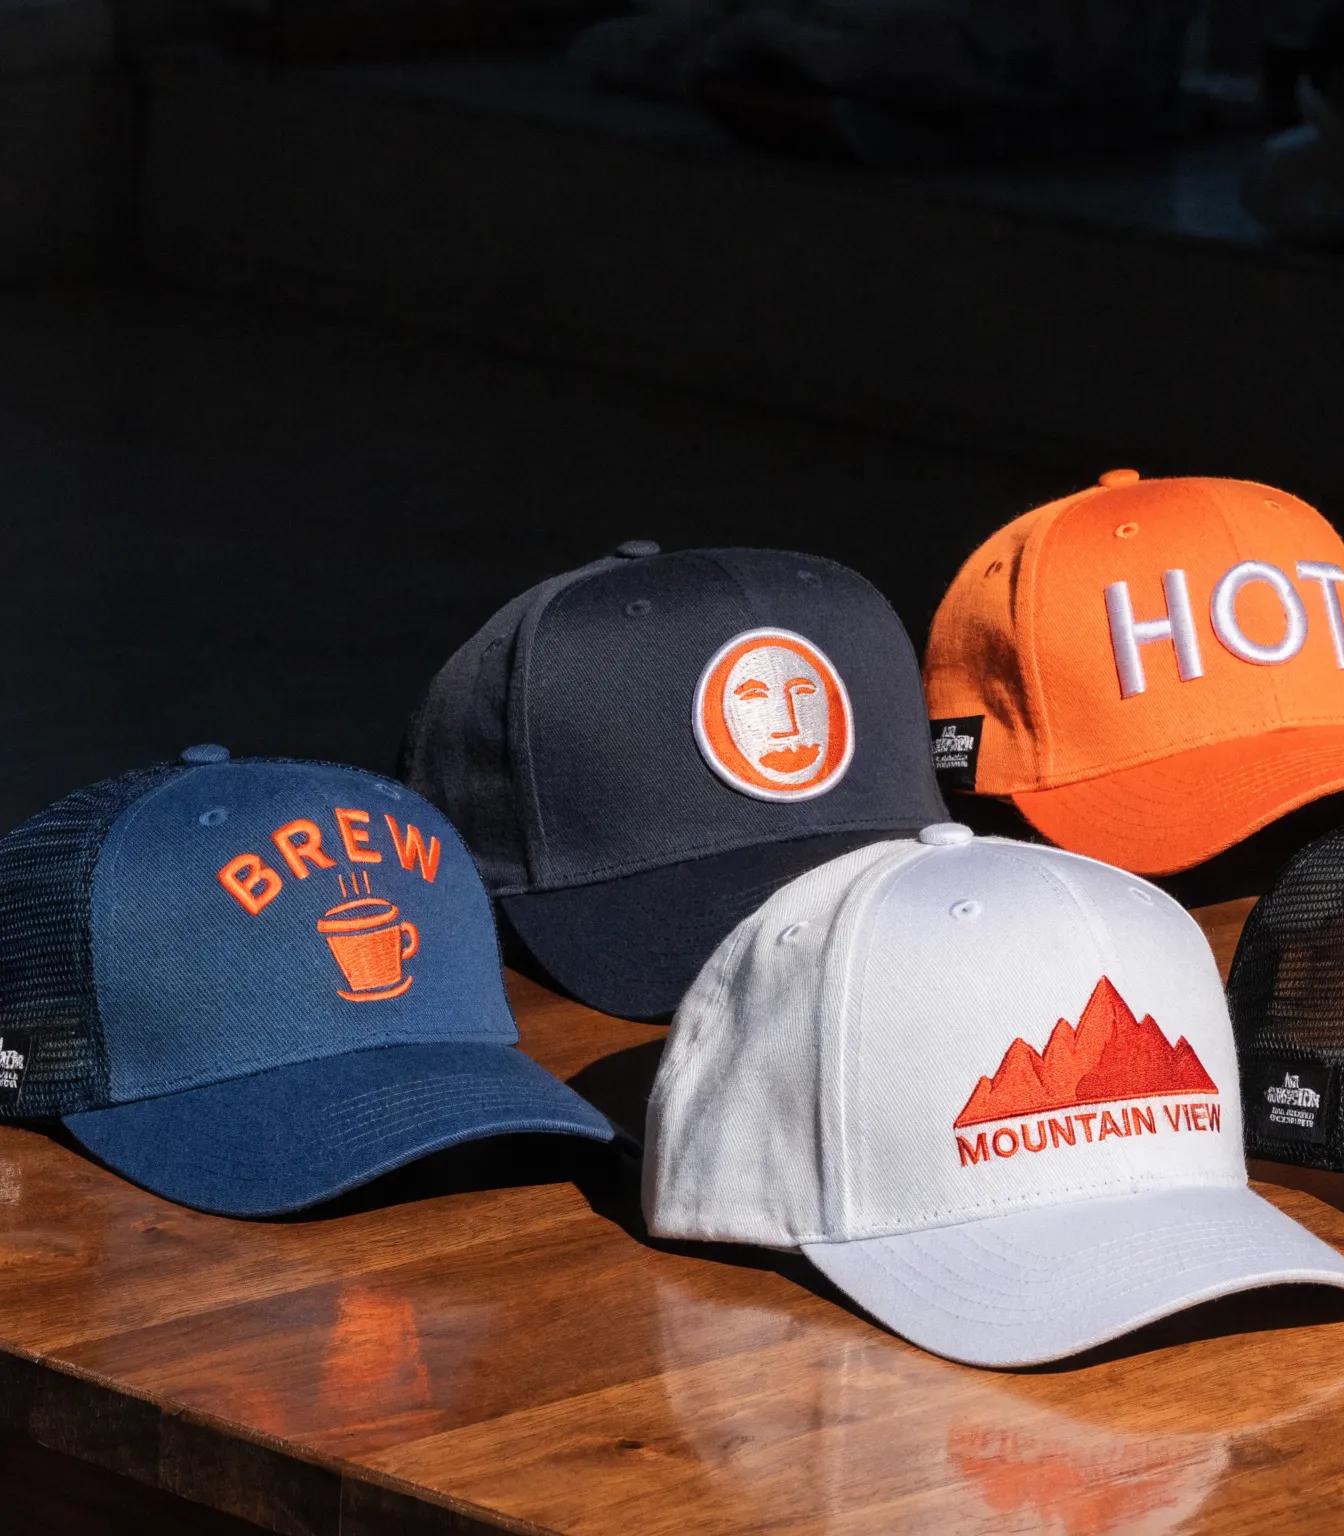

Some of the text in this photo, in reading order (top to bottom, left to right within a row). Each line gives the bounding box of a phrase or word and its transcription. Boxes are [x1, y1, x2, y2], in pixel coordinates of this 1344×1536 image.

[218, 808, 441, 916] BREW
[955, 1103, 1221, 1167] MOUNTAIN VIEW
